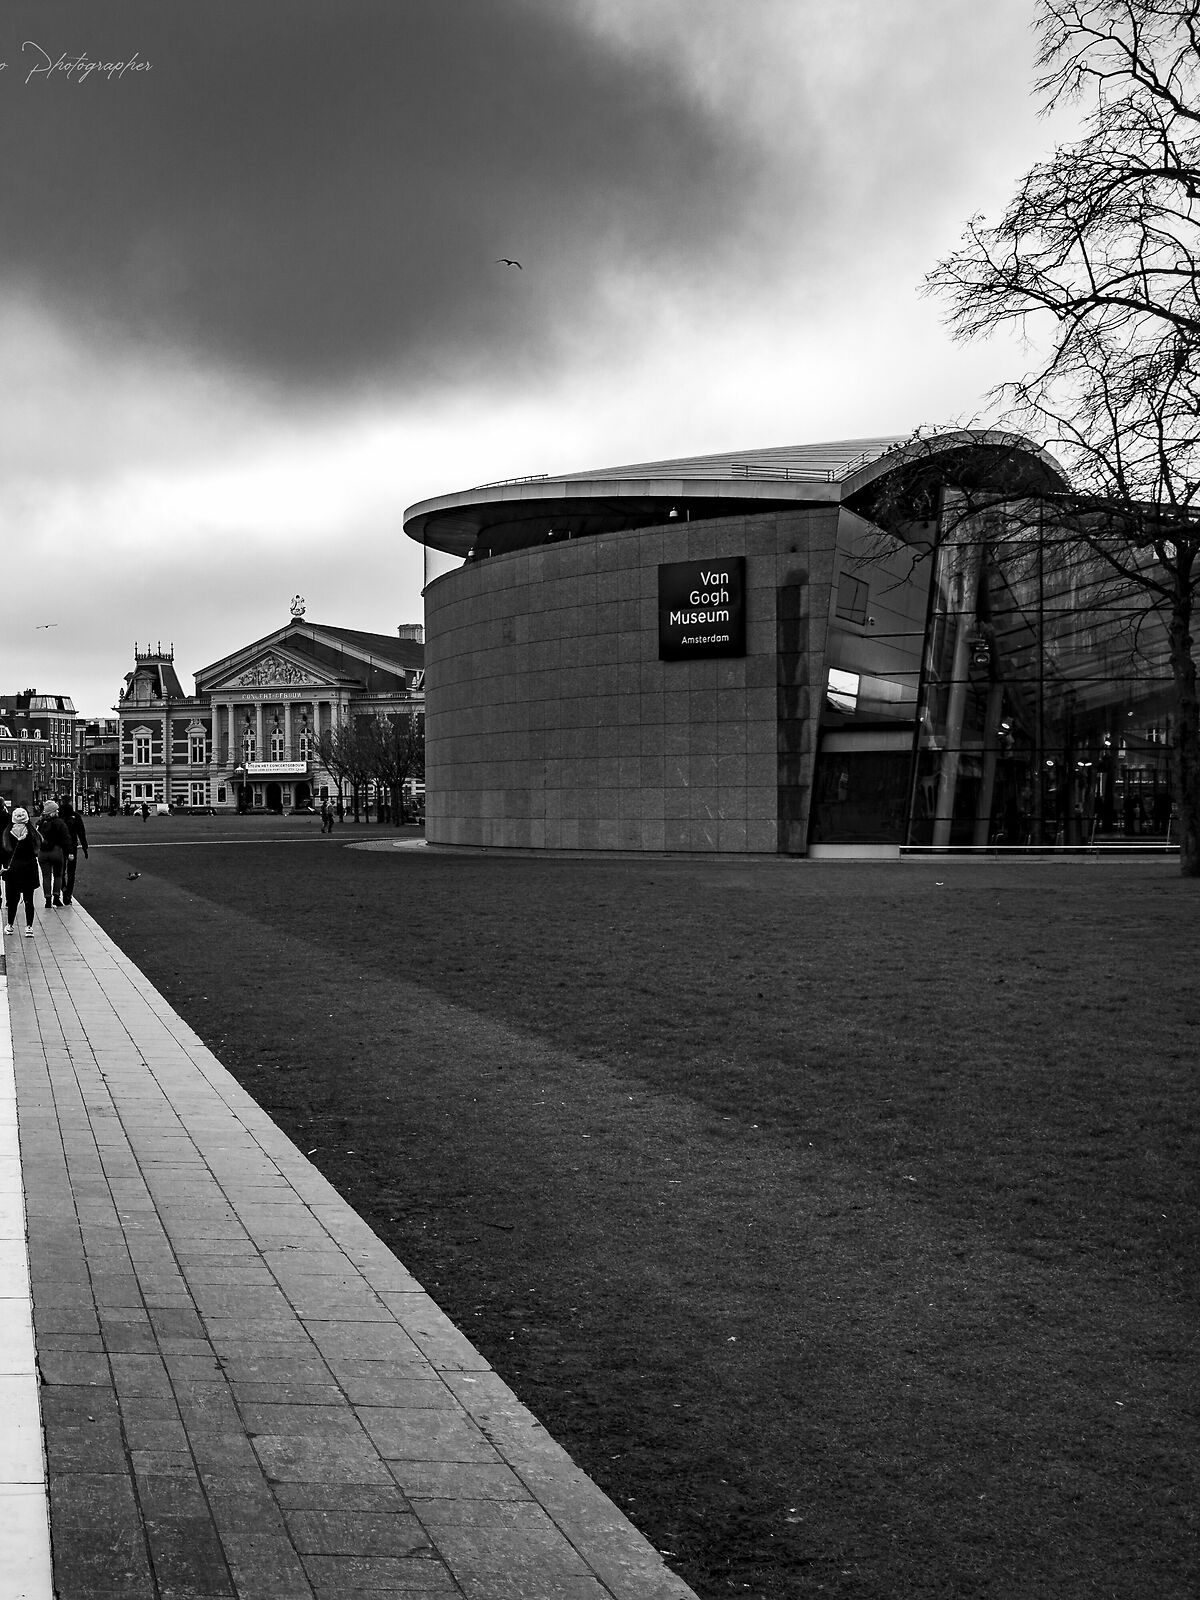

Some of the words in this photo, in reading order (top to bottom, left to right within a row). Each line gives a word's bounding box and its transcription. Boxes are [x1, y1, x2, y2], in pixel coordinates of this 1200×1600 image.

[700, 571, 729, 586] Van
[689, 588, 729, 606] Gogh
[669, 610, 729, 626] Museum
[681, 634, 729, 645] Amsterdam
